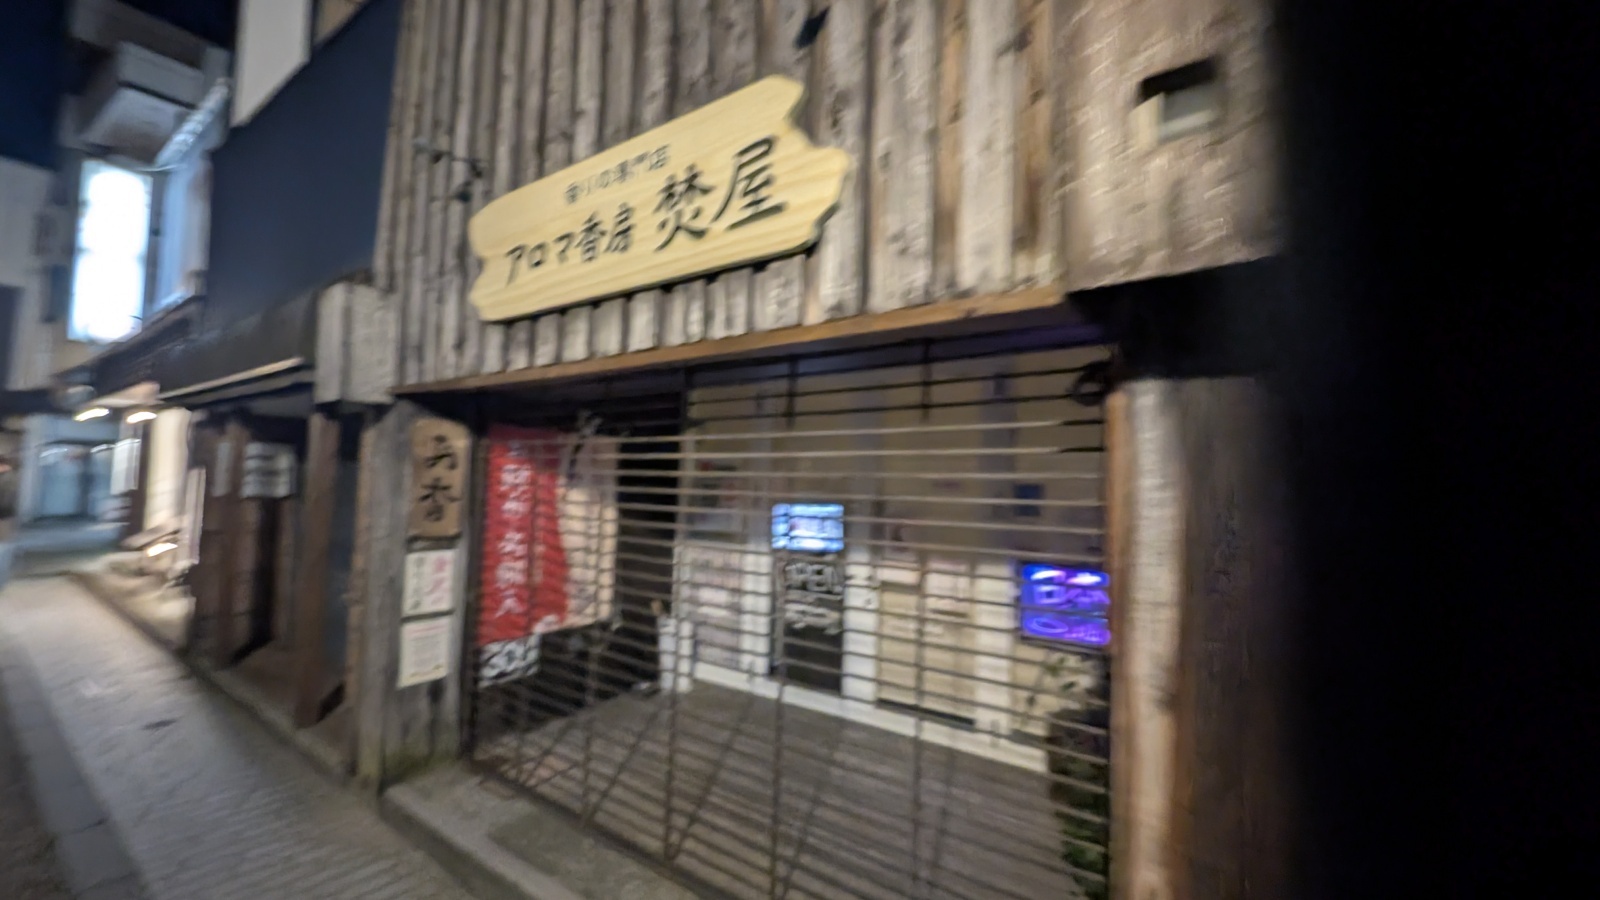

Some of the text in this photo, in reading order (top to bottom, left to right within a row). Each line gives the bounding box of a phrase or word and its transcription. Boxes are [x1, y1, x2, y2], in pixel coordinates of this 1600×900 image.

[504, 204, 635, 284] アロマ香房
